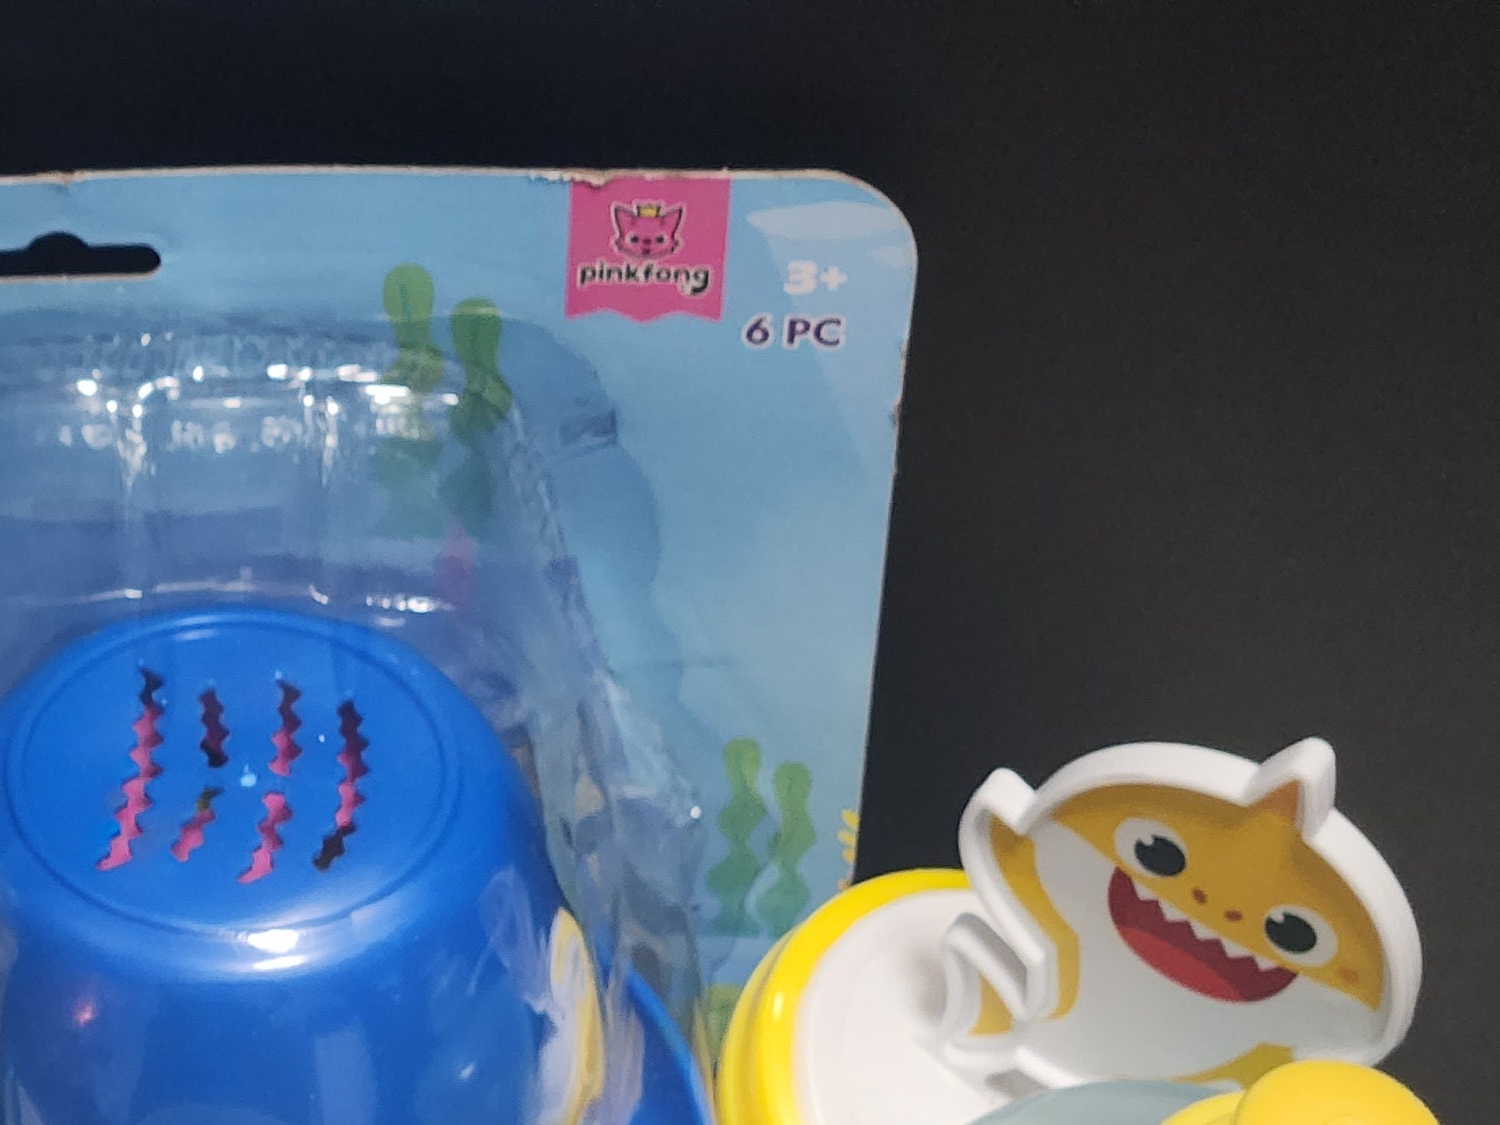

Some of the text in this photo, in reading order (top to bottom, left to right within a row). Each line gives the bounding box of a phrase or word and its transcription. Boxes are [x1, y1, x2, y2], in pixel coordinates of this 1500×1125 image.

[578, 261, 711, 297] pinkfong
[783, 259, 848, 296] 3+
[744, 314, 846, 350] 6 PC
